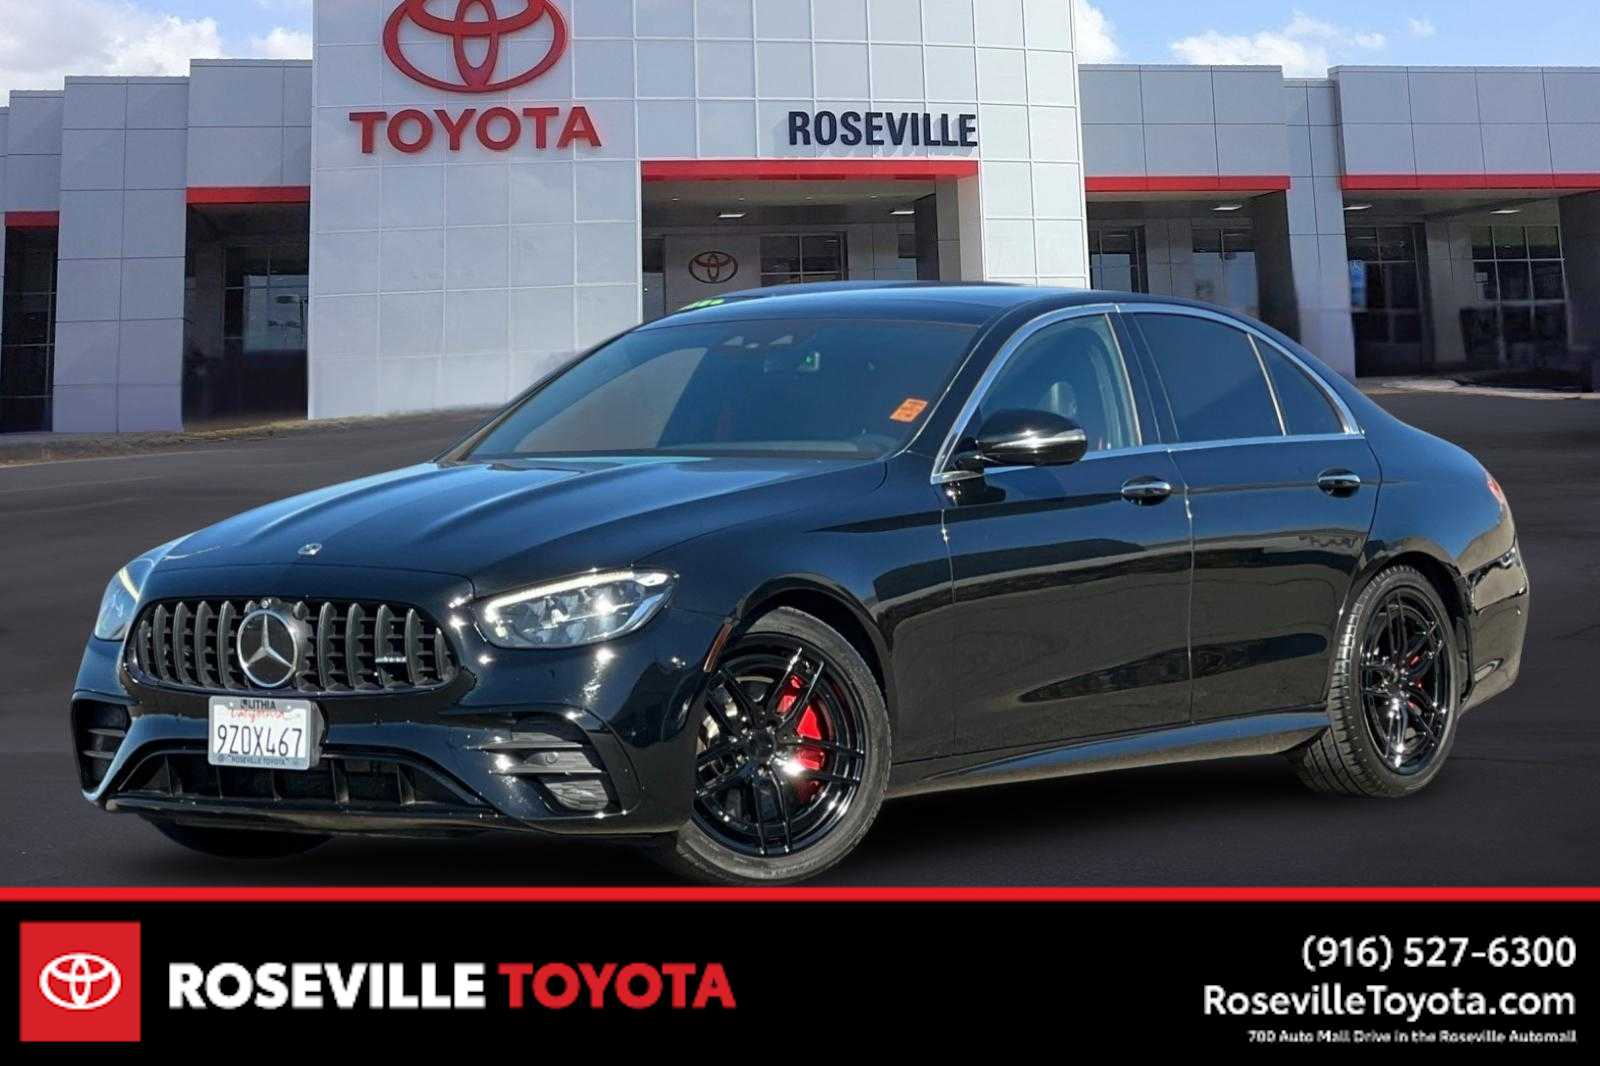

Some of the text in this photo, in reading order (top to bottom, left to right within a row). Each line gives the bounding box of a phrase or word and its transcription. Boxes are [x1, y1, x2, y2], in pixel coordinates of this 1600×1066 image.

[350, 106, 602, 154] TOYOTA
[789, 111, 978, 147] ROSEVILLE
[247, 699, 277, 710] LITHIA
[262, 757, 286, 766] TOYOTA
